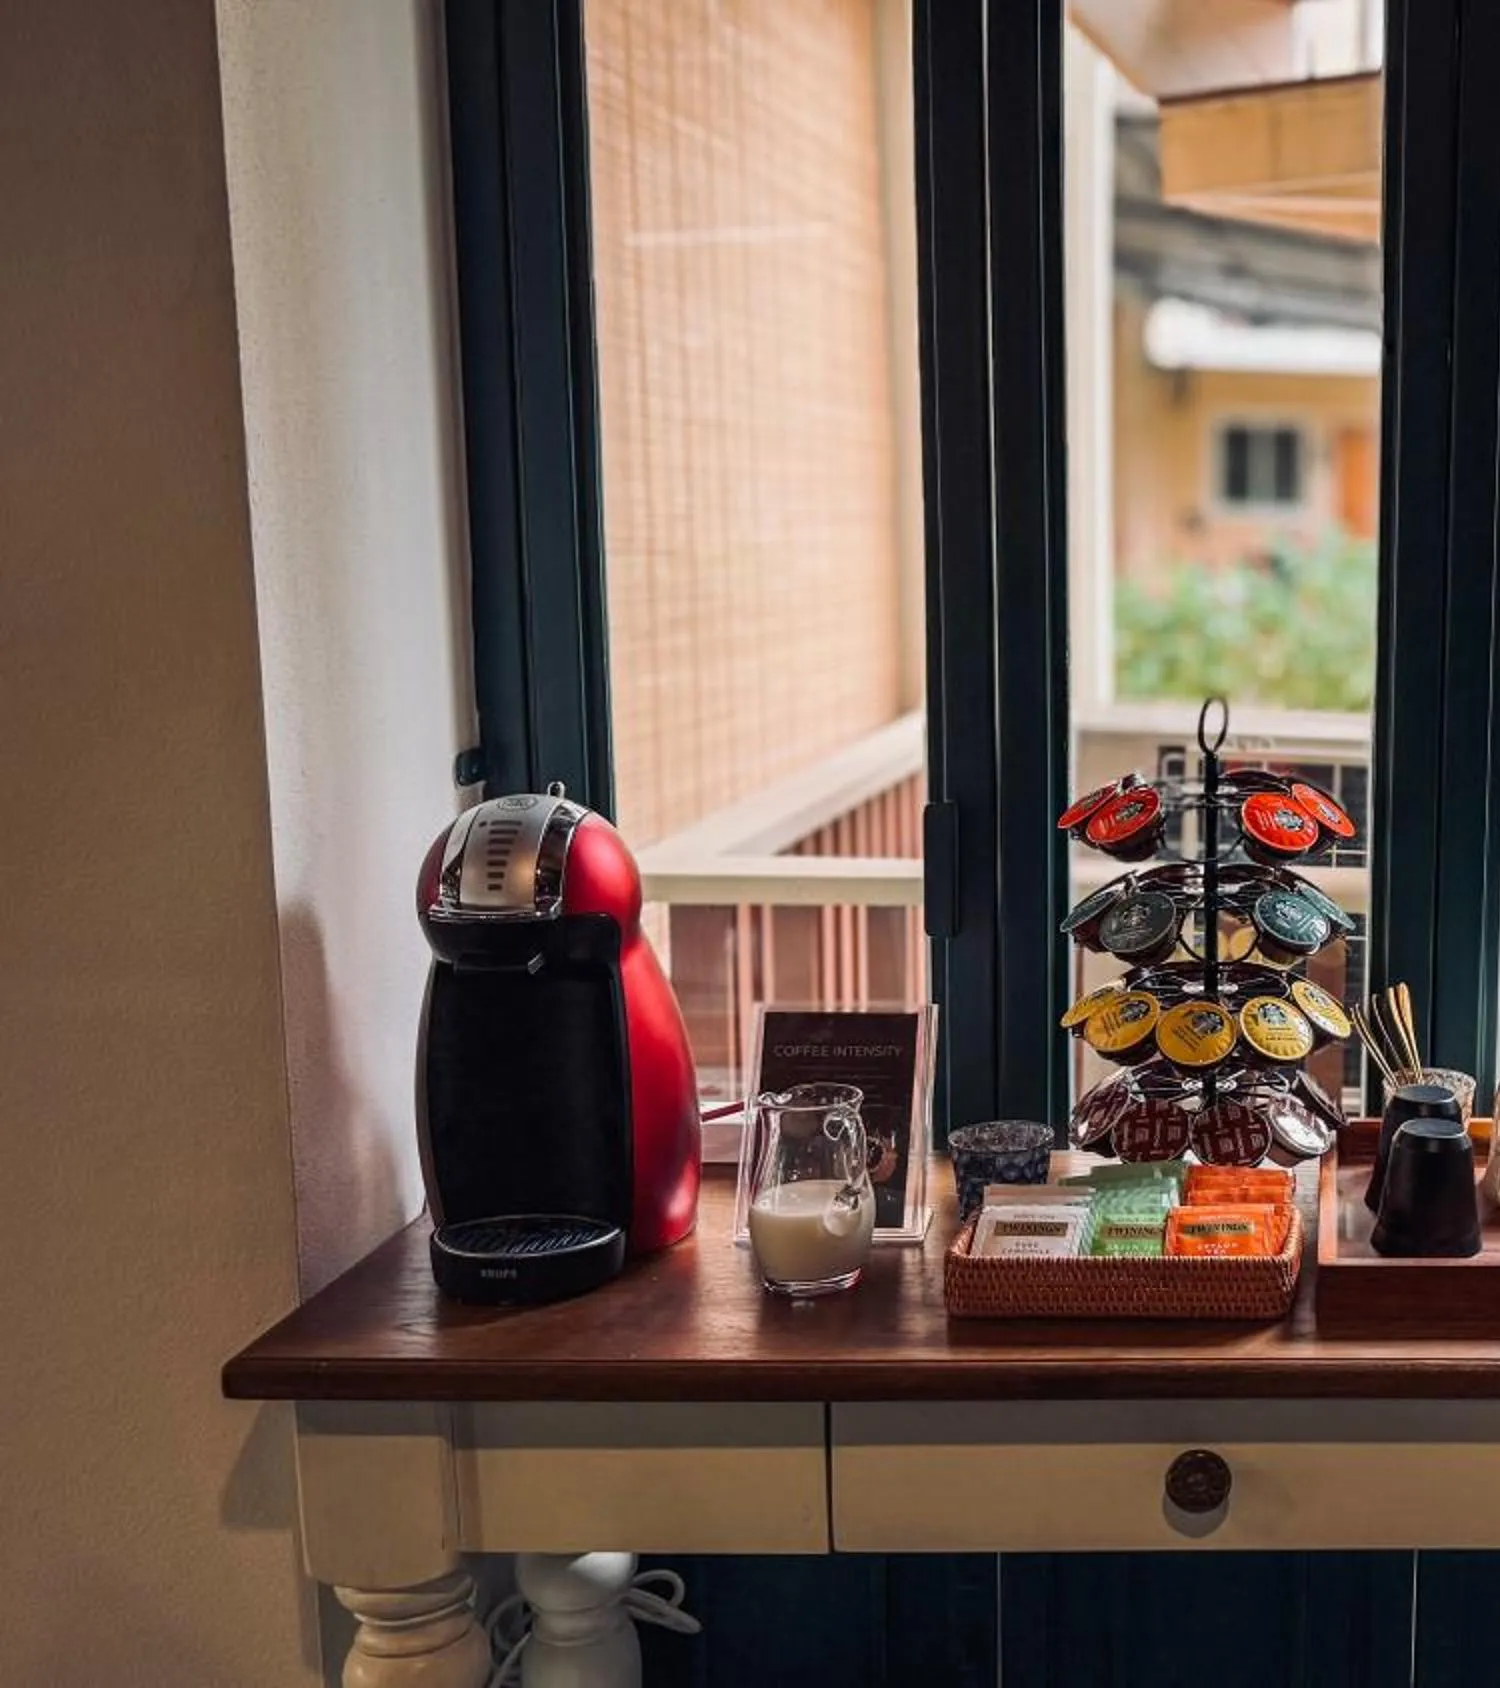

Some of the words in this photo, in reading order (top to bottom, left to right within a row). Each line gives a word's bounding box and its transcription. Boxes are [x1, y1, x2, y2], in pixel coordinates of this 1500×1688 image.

[773, 1045, 829, 1057] COFFEE
[832, 1045, 902, 1057] INTENSITY
[1003, 1222, 1062, 1234] TWININGS
